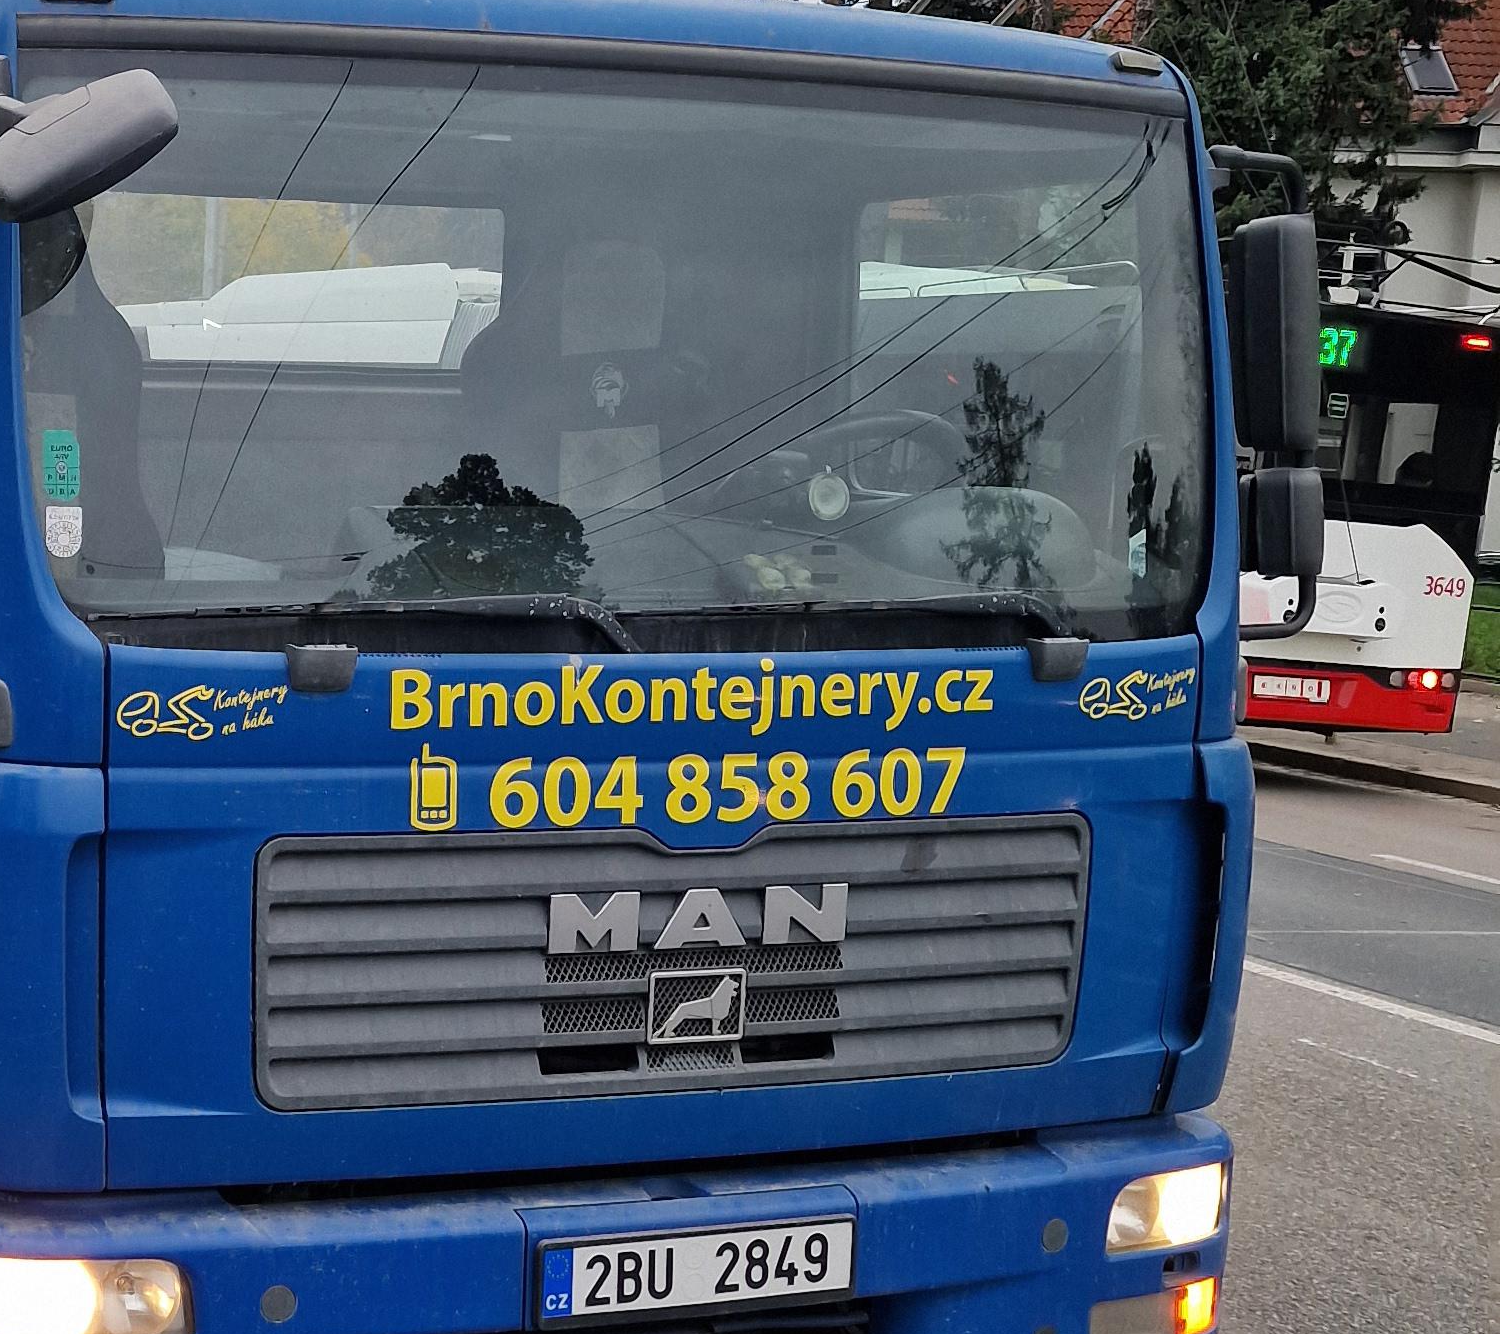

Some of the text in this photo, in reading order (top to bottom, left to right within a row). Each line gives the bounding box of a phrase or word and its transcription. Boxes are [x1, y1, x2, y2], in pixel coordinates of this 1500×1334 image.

[1423, 575, 1466, 598] 3649
[213, 685, 288, 712] Kontejnery
[221, 722, 236, 736] na
[390, 658, 994, 737] BrnoKontejnery.cz
[489, 746, 967, 829] 604 858 607
[548, 882, 849, 954] MAN
[545, 1232, 830, 1311] CZ 2BU 2849
